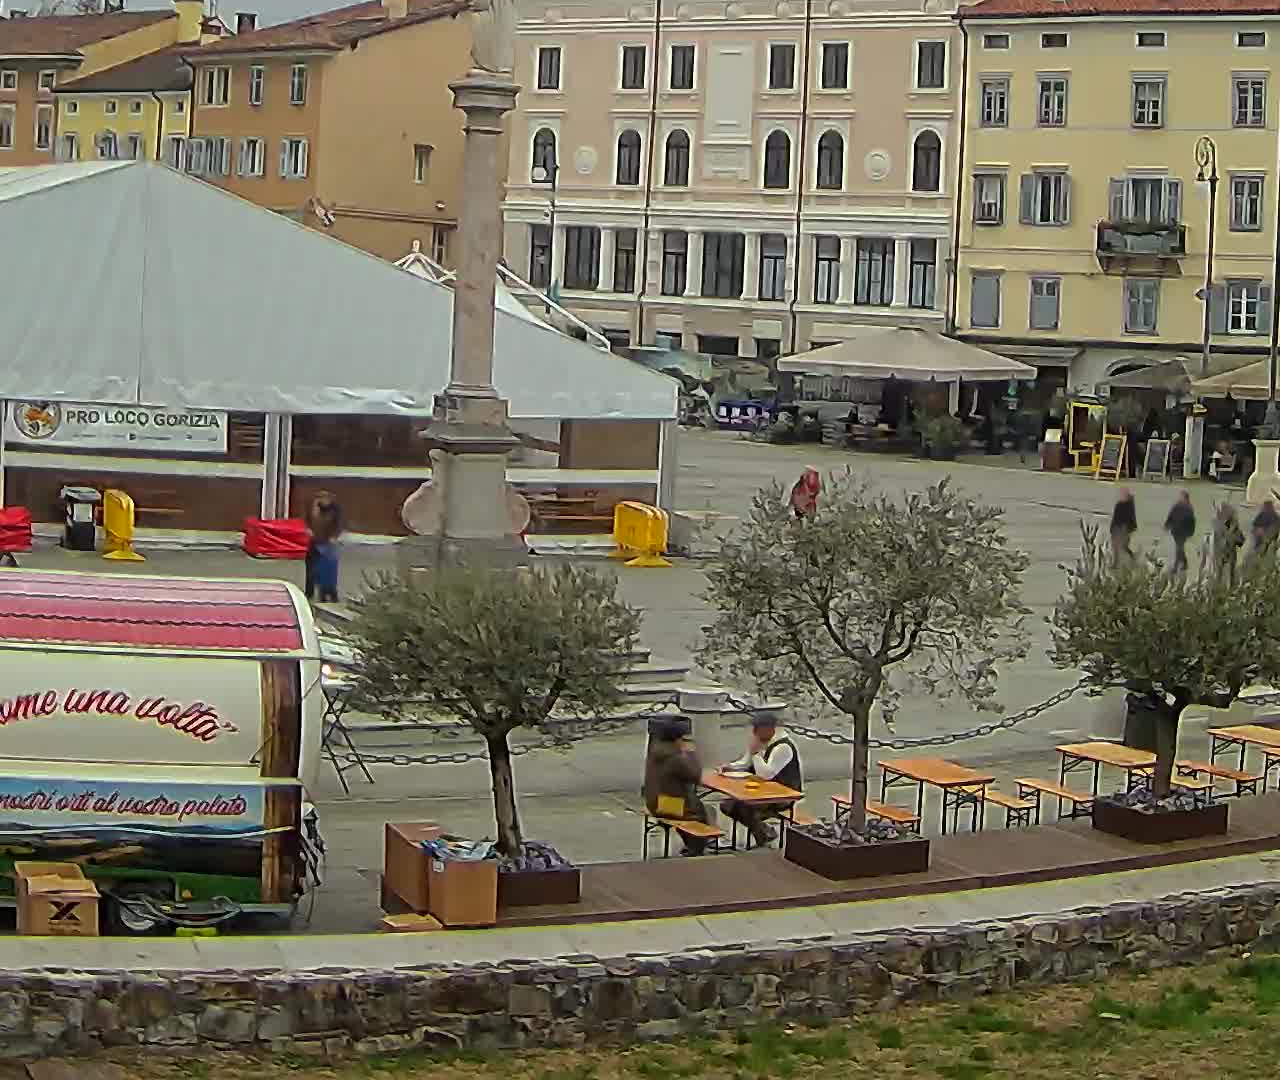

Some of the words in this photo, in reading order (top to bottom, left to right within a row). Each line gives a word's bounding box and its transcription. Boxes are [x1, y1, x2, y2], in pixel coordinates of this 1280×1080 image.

[66, 410, 100, 425] PRO
[105, 410, 149, 426] LOCO
[153, 413, 220, 427] GORIZIA
[63, 688, 131, 714] una
[55, 791, 93, 812] orti
[93, 791, 119, 813] al
[120, 793, 177, 816] vostro
[177, 794, 247, 821] palato
